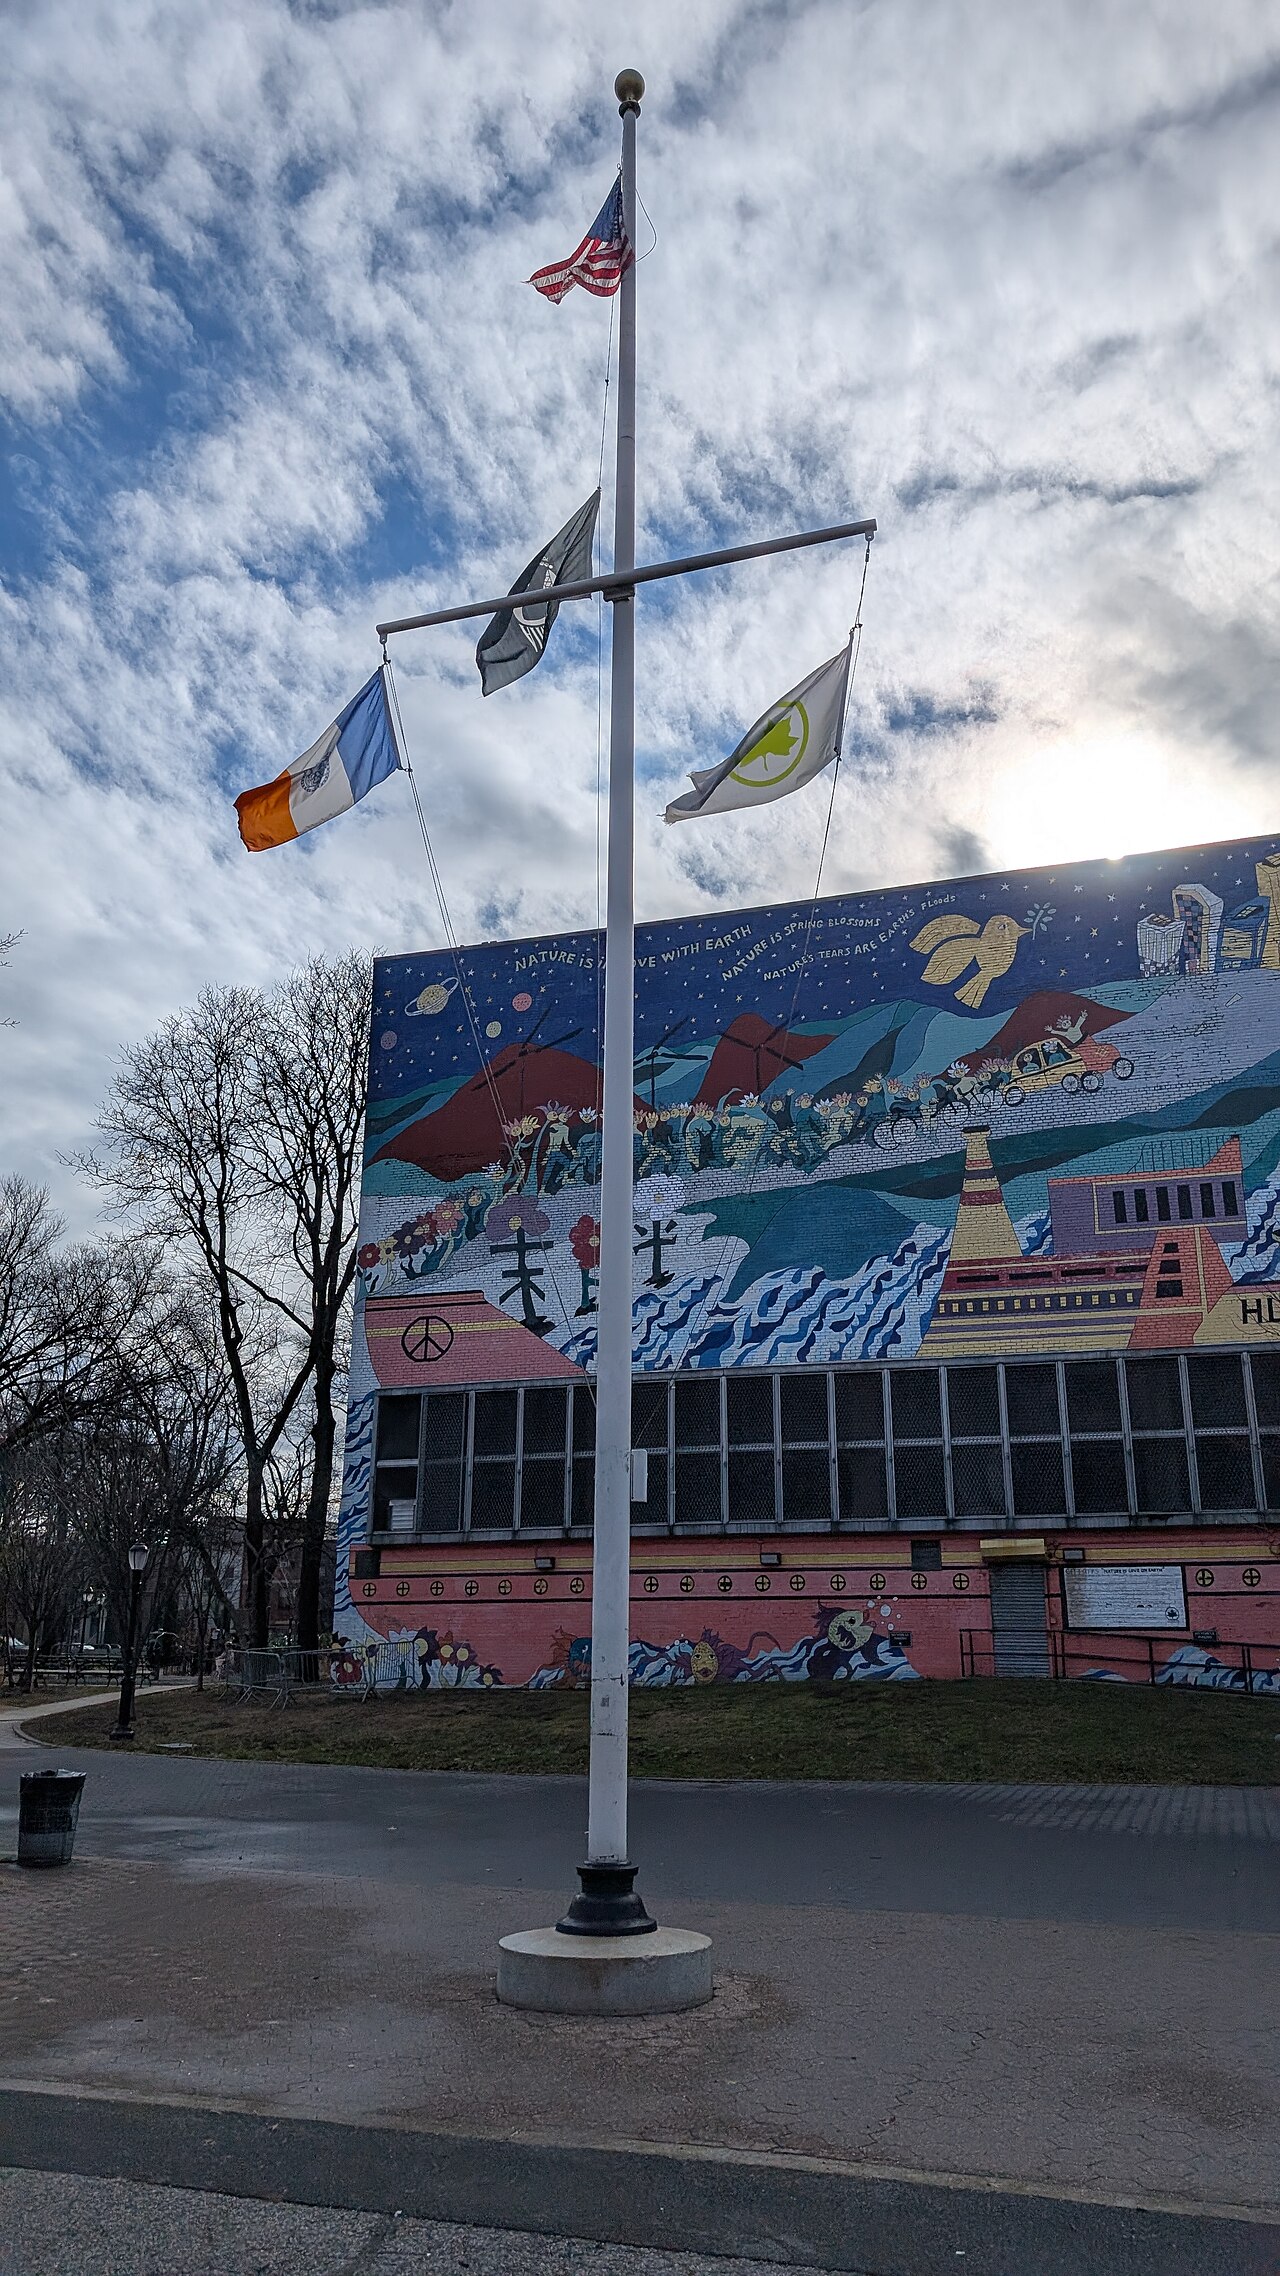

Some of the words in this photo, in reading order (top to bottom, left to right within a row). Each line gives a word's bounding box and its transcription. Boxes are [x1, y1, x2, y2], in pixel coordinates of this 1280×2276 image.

[514, 950, 576, 972] NATURE
[705, 924, 752, 951] EARTH
[721, 939, 768, 982] NATURE
[783, 919, 824, 936] SPRING
[828, 917, 881, 927] BLOSSOMS
[763, 953, 814, 981] NATURE'S
[818, 947, 851, 959] TEARS
[854, 940, 878, 955] ARE
